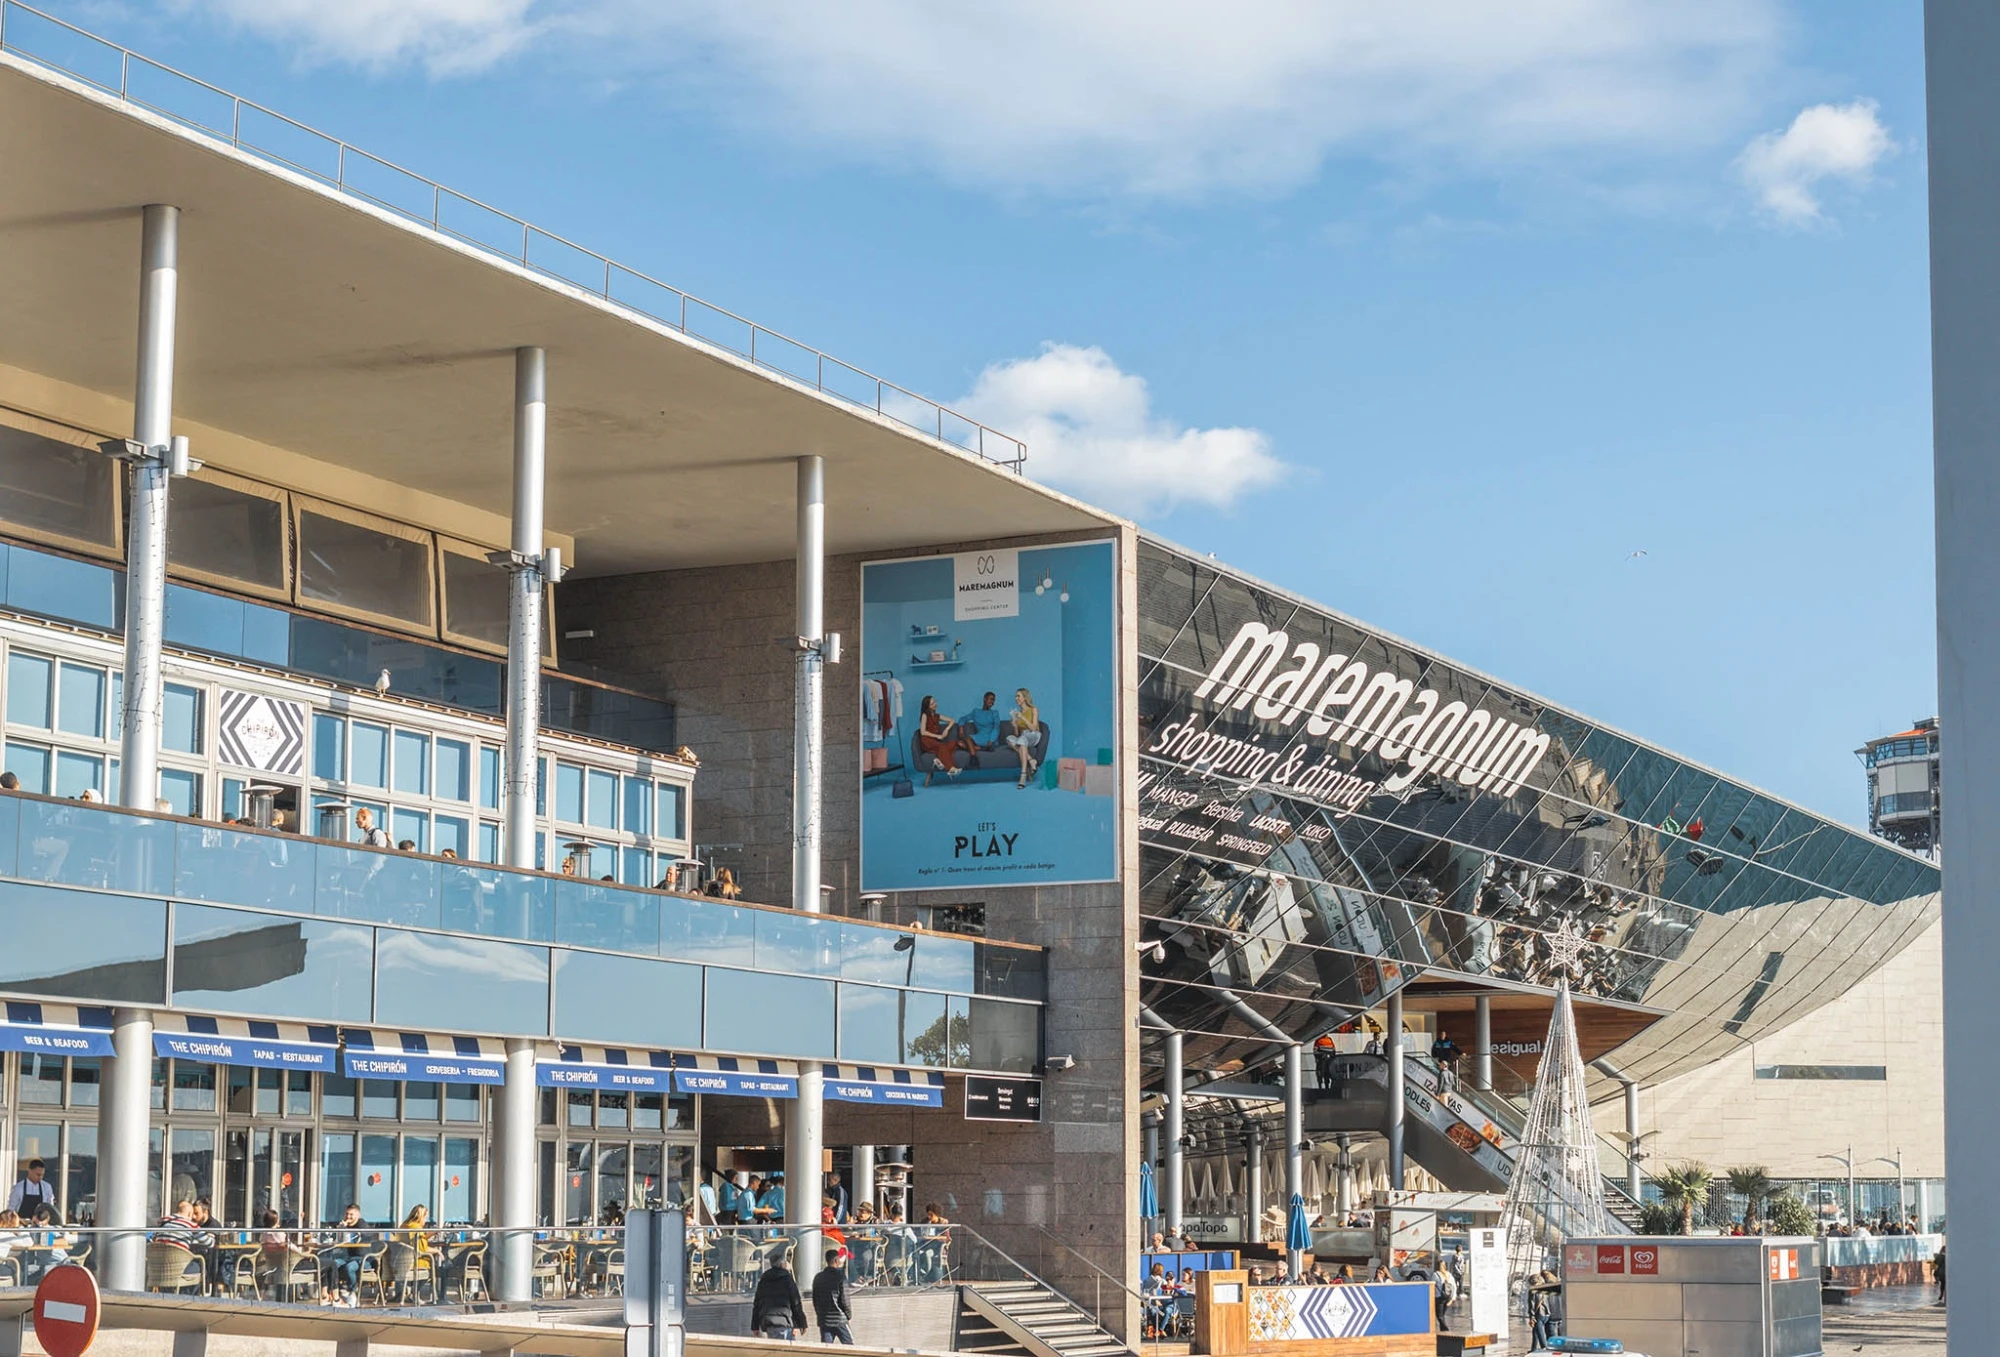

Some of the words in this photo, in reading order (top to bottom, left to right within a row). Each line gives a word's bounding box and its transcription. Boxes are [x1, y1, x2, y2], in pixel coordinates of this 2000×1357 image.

[959, 580, 1014, 592] MAREMAGNUM
[1193, 621, 1551, 797] maremagnum
[1149, 713, 1277, 791] shopping
[1271, 743, 1308, 785] &
[1292, 755, 1376, 819] dining
[1146, 786, 1199, 807] MANGO
[1202, 800, 1245, 822] Bershka
[1249, 815, 1291, 834] LACOSTE
[1301, 824, 1332, 839] KIKO
[977, 822, 997, 832] LET'S
[954, 833, 1019, 858] PLAY
[1166, 821, 1214, 842] PULL&BEAR
[1216, 834, 1273, 856] SPRINGFIELD
[53, 1037, 89, 1049] SEAFOOD
[169, 1041, 188, 1052] THE
[190, 1042, 232, 1057] CHIPIRÓN
[253, 1050, 275, 1060] TAPAS
[282, 1053, 323, 1064] RESTAURANT
[1491, 1039, 1541, 1058] esigual
[351, 1060, 369, 1071] THE
[370, 1060, 407, 1074] CHIPIRÓN
[425, 1065, 461, 1076] CERVESERIA
[550, 1070, 565, 1082] THE
[566, 1069, 598, 1083] CHIPIRÓN
[685, 1077, 698, 1087] THE
[740, 1081, 756, 1090] TAPAS
[836, 1086, 848, 1097] THE
[1404, 1086, 1432, 1113] ODLES
[1424, 1079, 1463, 1114] IZAYAS
[1180, 1221, 1228, 1235] apaTapa
